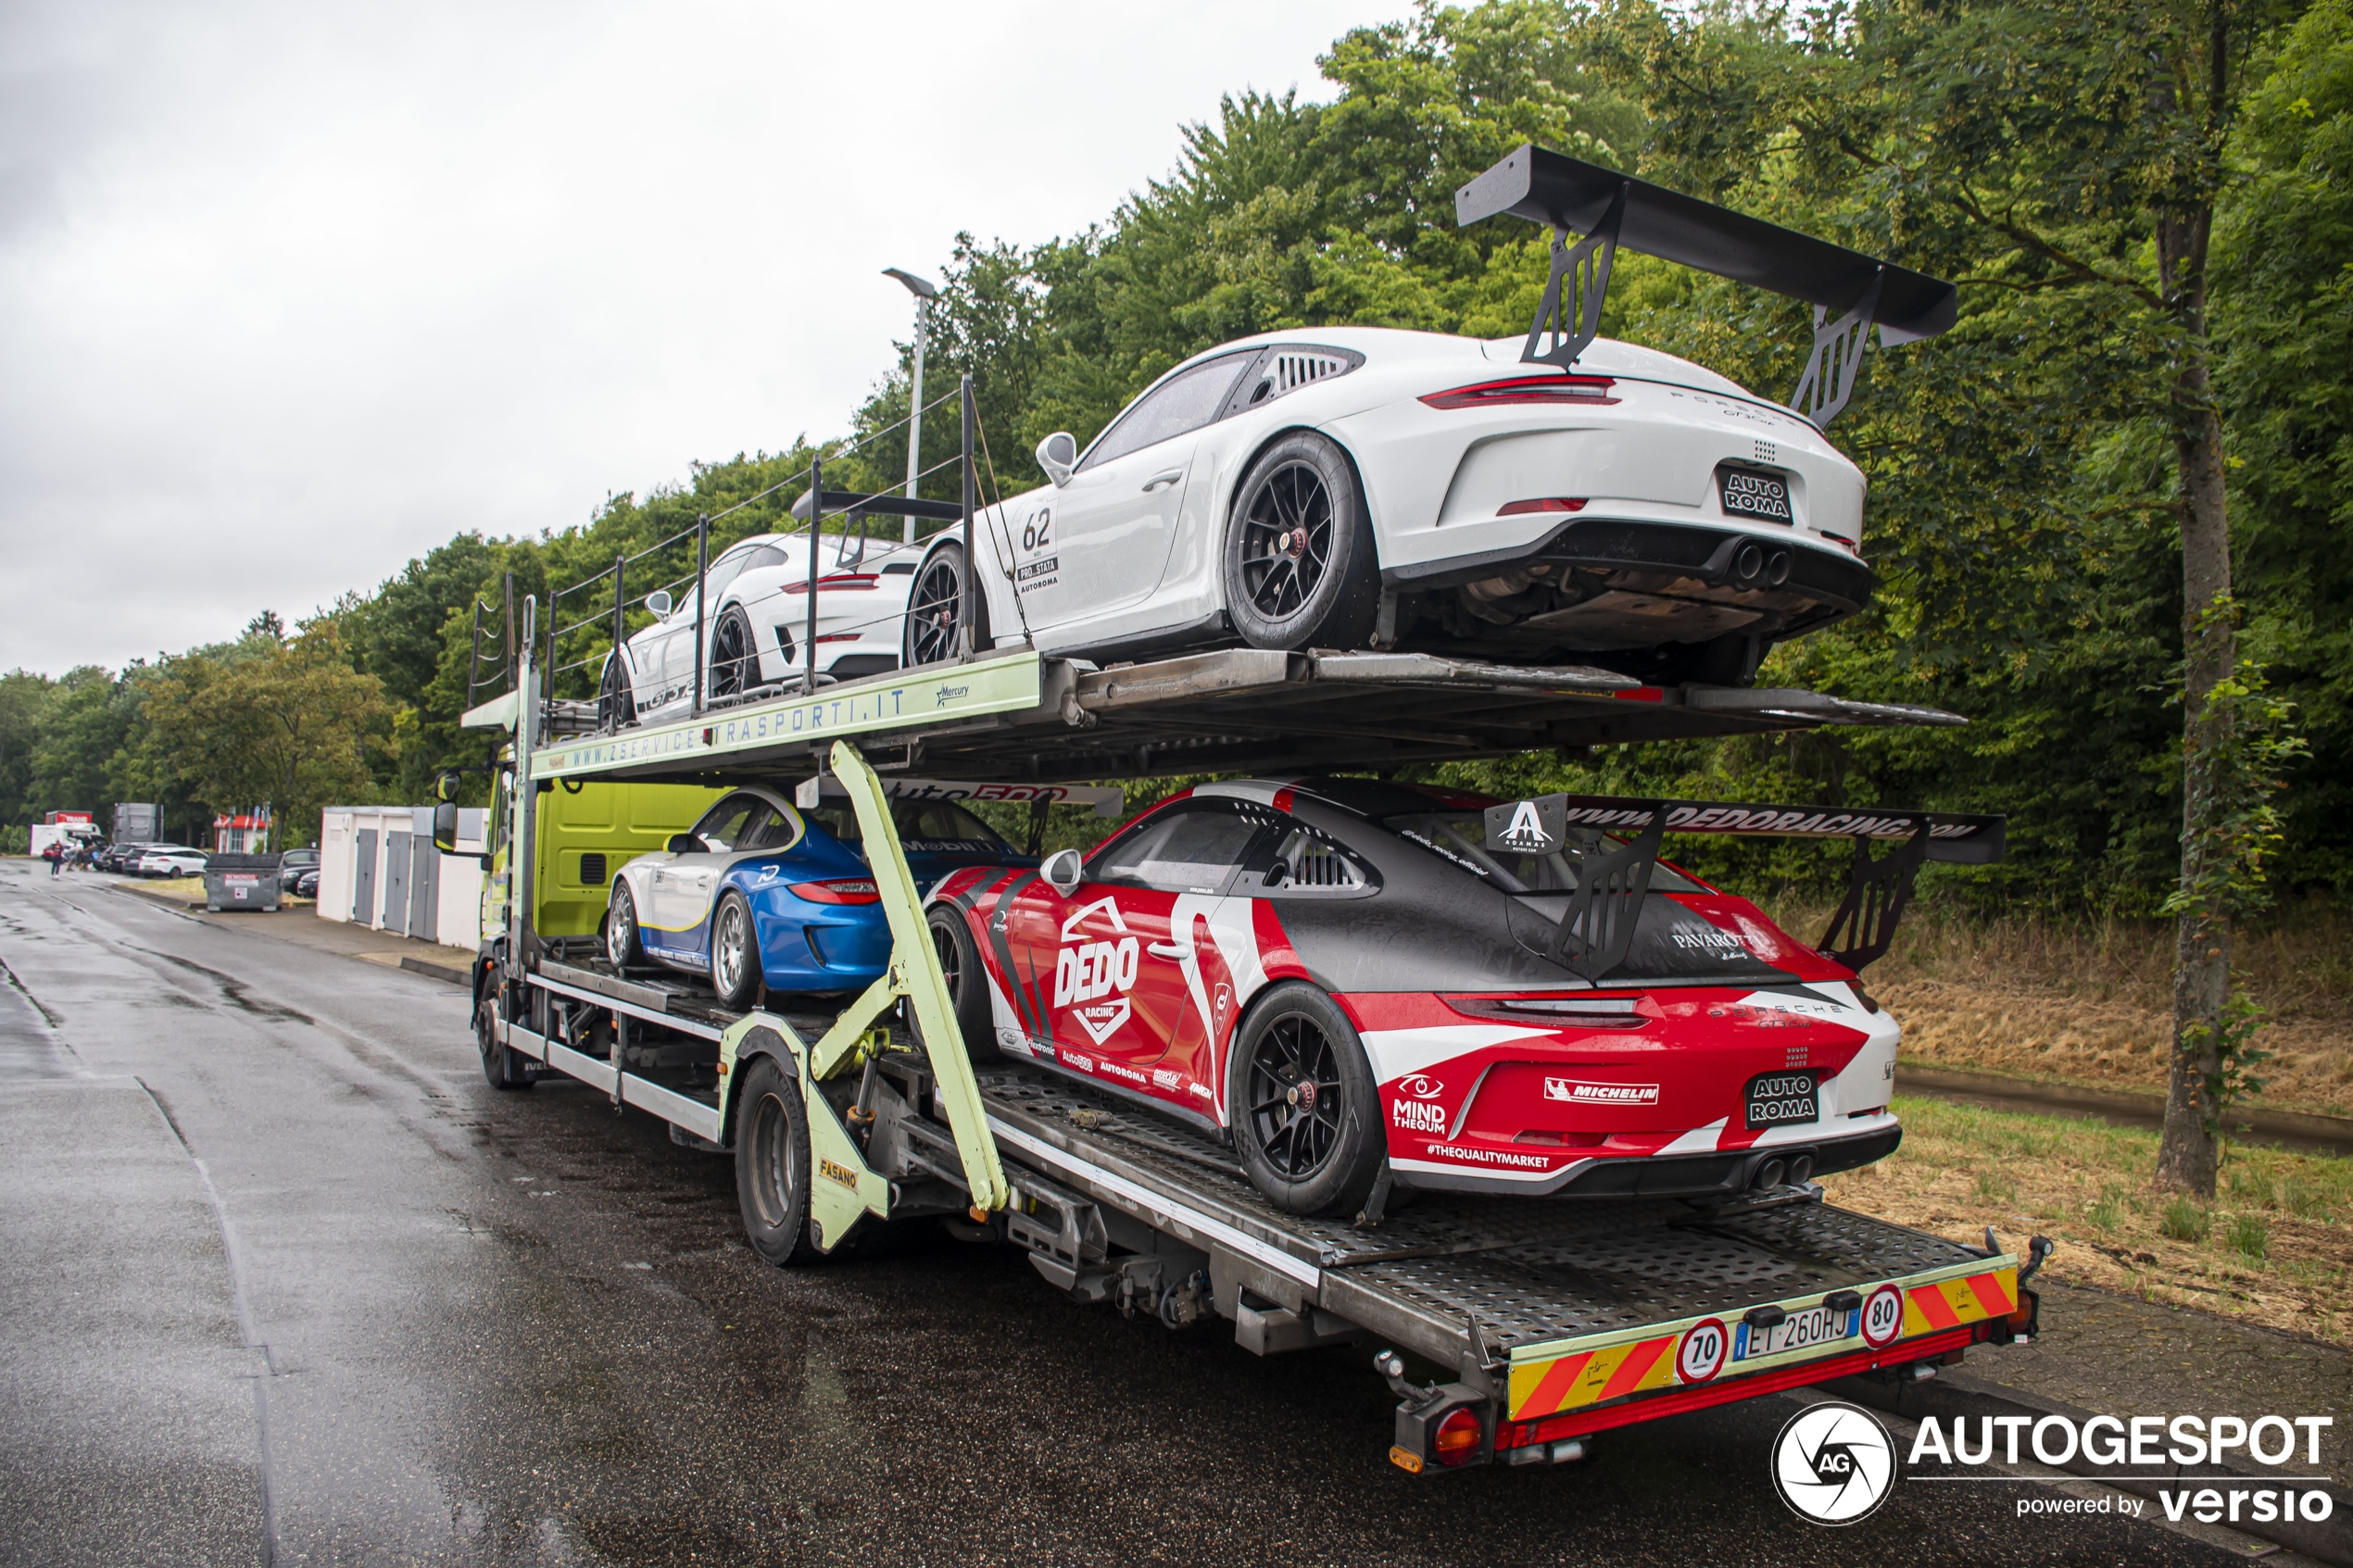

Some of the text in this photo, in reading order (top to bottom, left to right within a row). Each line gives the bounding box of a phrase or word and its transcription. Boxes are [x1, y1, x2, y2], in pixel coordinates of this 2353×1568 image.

[1729, 474, 1784, 498] AUTO
[1724, 491, 1790, 518] ROMA
[1024, 507, 1051, 552] 62
[1021, 576, 1058, 594] AUTOROMA
[650, 684, 679, 709] GT3
[941, 685, 970, 698] Mercury
[900, 840, 976, 852] Mobil
[1505, 839, 1545, 848] ADAMAS
[1671, 934, 1765, 948] PAVAROTTI
[1053, 935, 1140, 1009] DEDO
[1085, 1006, 1114, 1018] RACING
[1710, 1005, 1843, 1019] PORSCHE
[1757, 1019, 1812, 1029] GT3 Cup
[1027, 1038, 1055, 1056] Flextronic
[1062, 1049, 1093, 1073] Auto500
[1100, 1060, 1147, 1084] AUTOROMA
[1573, 1085, 1657, 1099] MICHELIN
[1753, 1075, 1811, 1098] AUTO
[1393, 1098, 1446, 1124] MIND
[1750, 1098, 1816, 1121] ROMA
[1393, 1116, 1445, 1135] THEGUM
[1427, 1144, 1549, 1168] #THEQUALITYMARKET
[820, 1160, 856, 1188] FASANO
[1872, 1298, 1894, 1327] 80
[1783, 1307, 1847, 1348] 260HJ
[1692, 1333, 1717, 1363] 70
